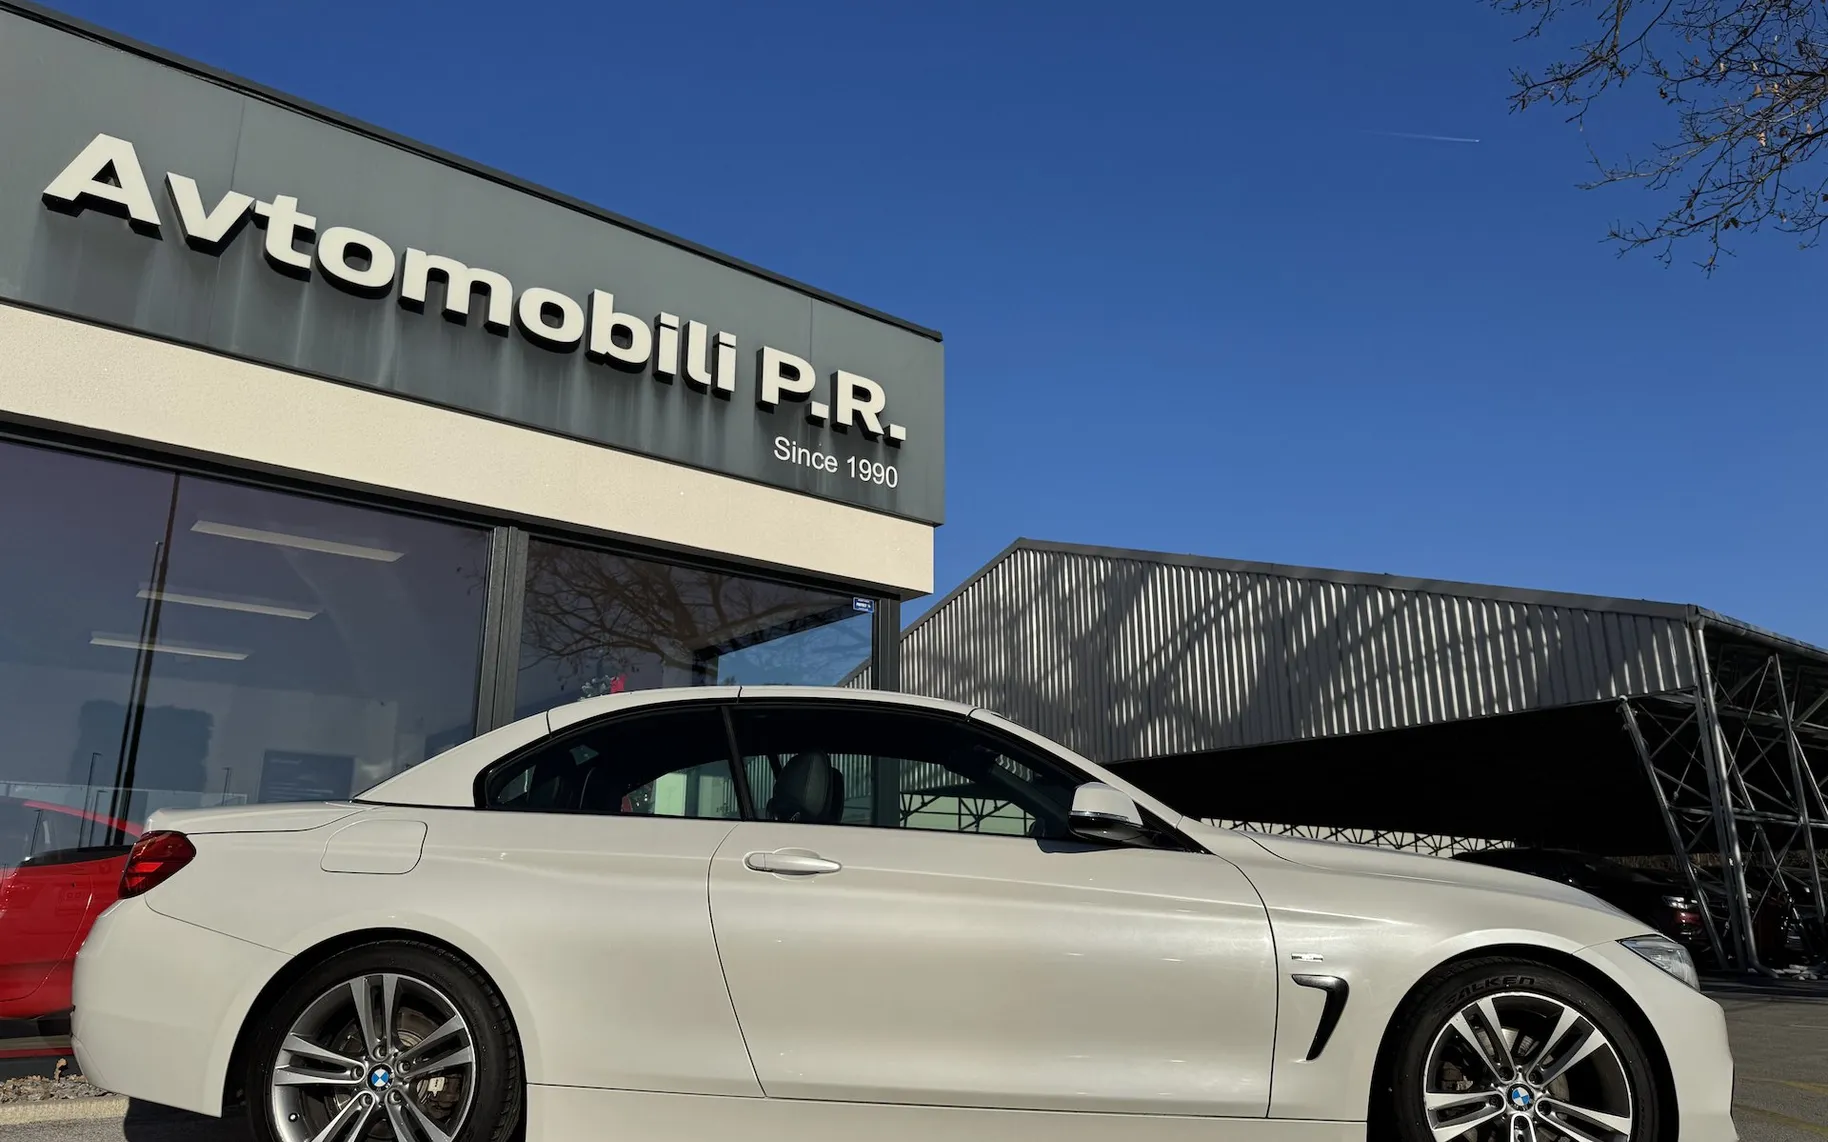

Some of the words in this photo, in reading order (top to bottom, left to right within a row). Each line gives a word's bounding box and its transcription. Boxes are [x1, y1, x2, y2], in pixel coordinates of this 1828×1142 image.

[42, 133, 737, 395] Avtomobili
[757, 346, 906, 442] P.R.
[774, 436, 839, 473] Since
[847, 455, 898, 488] 1990
